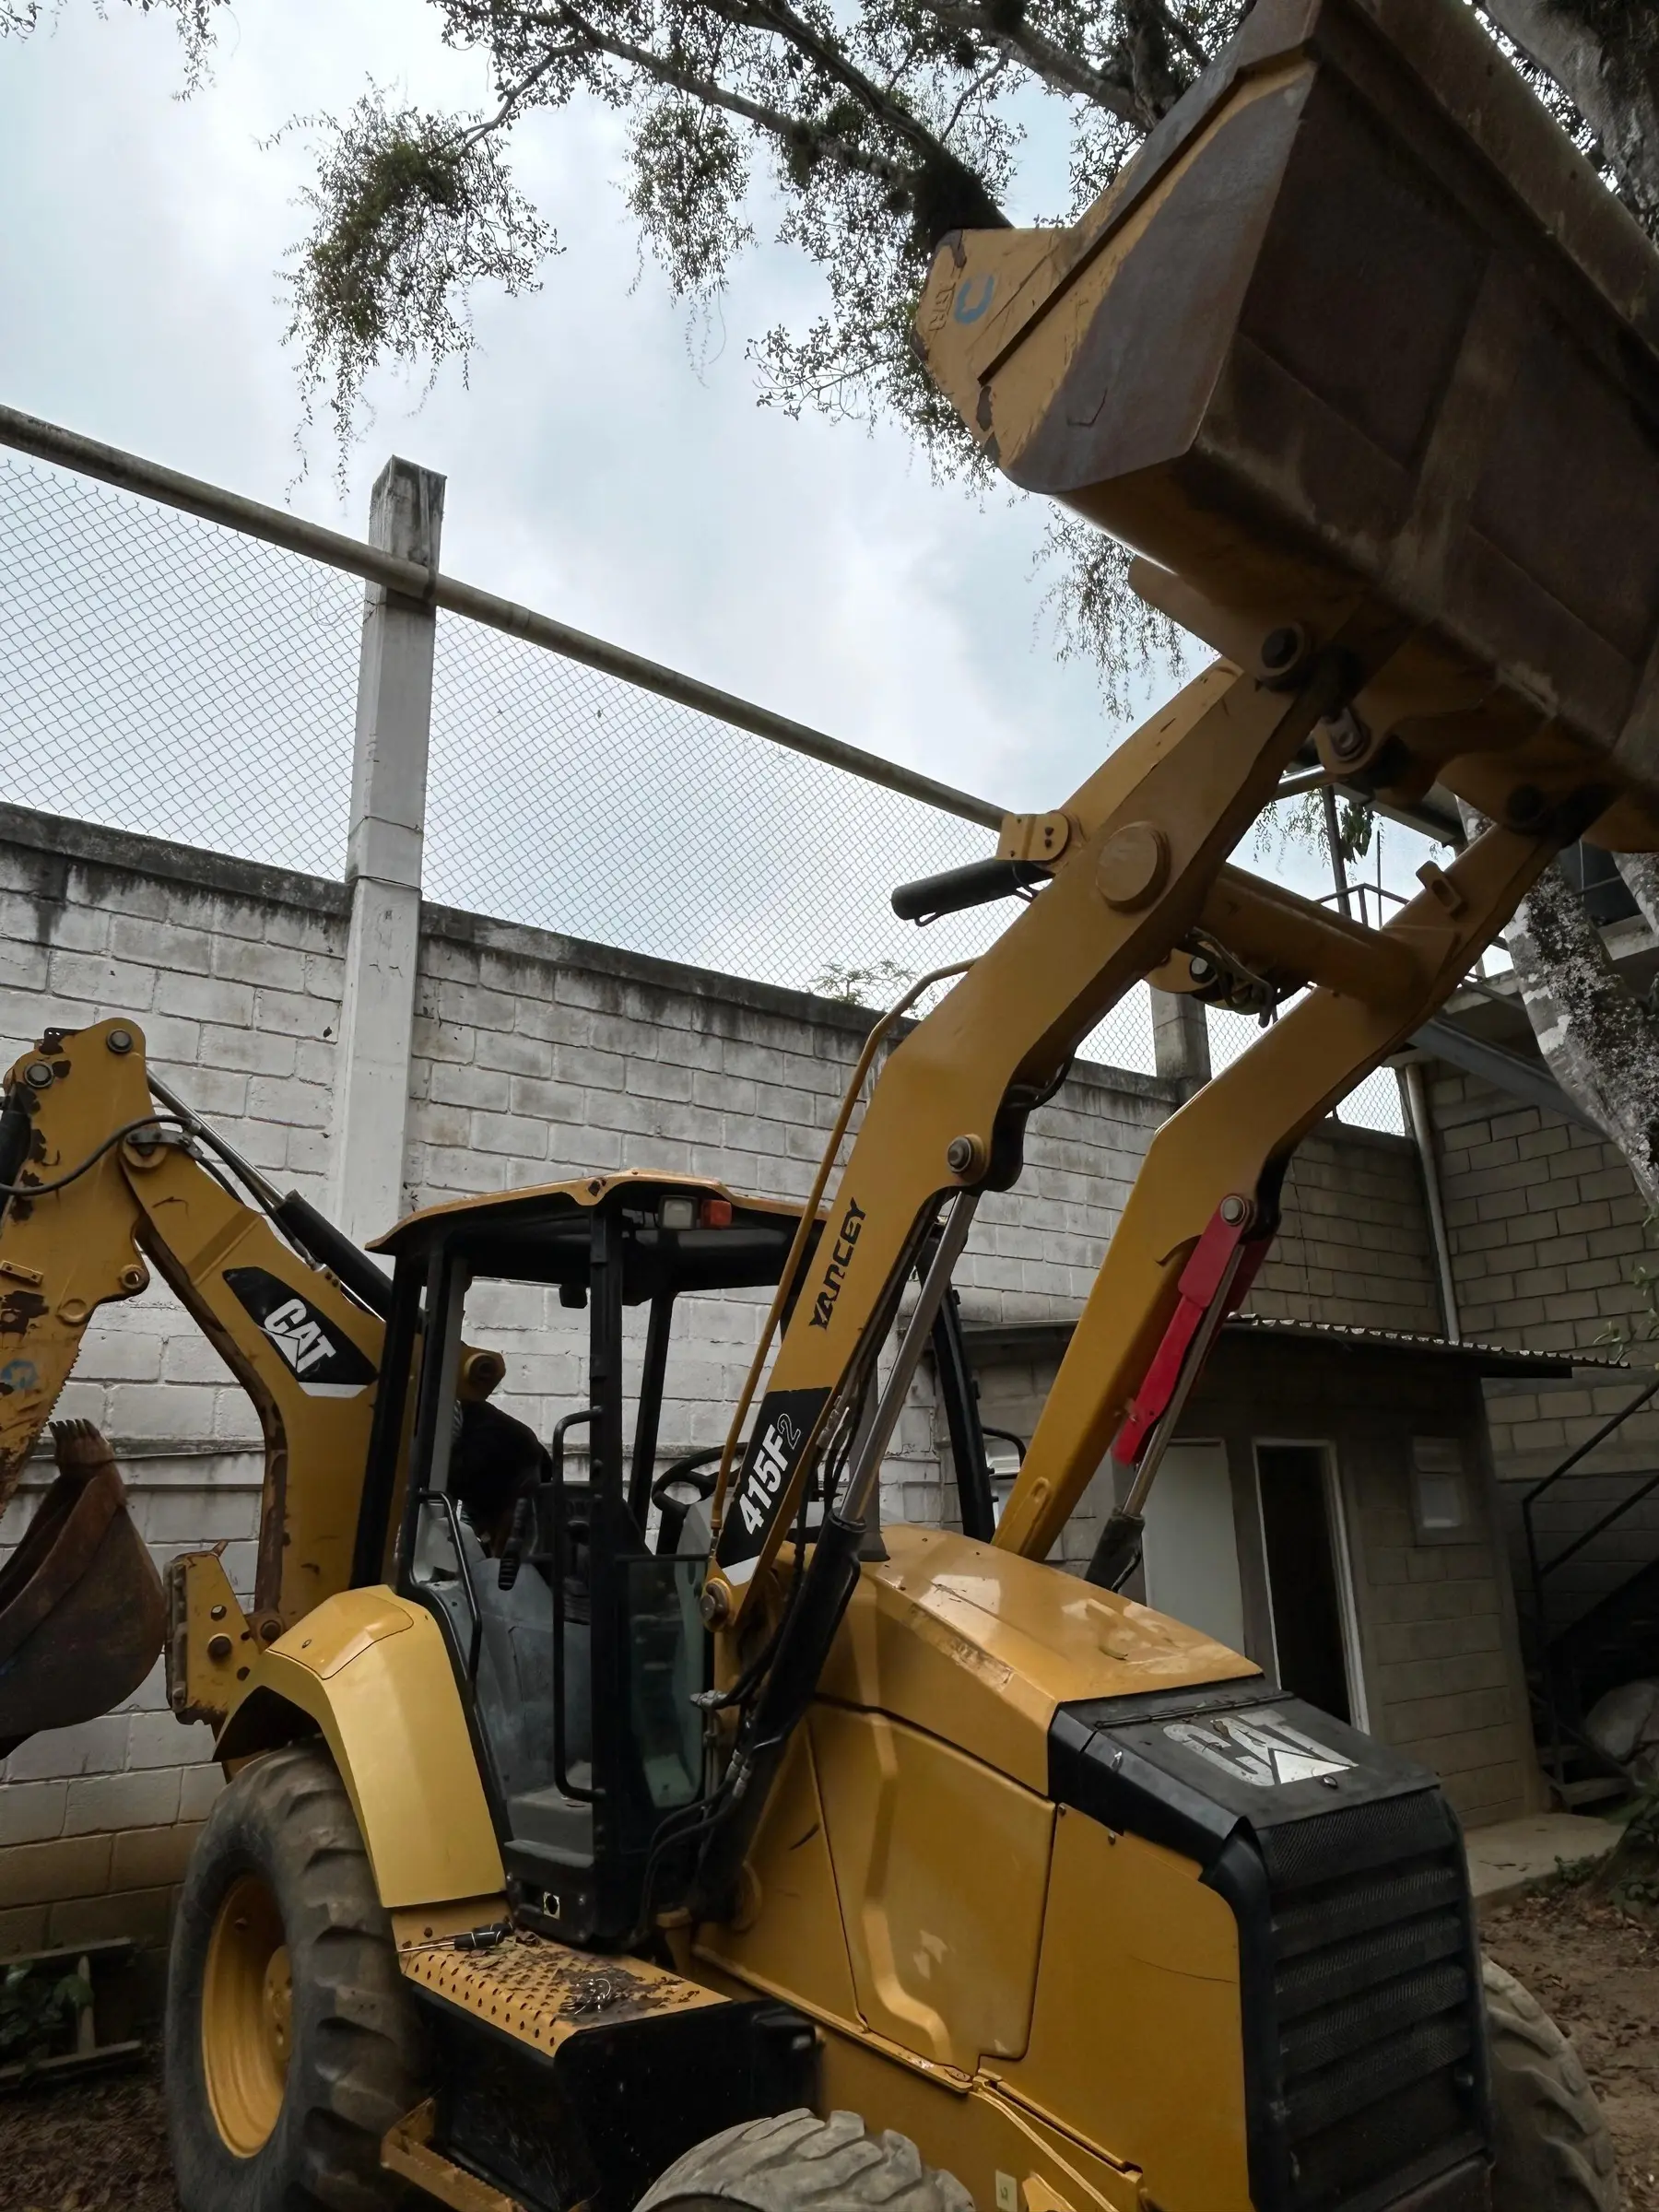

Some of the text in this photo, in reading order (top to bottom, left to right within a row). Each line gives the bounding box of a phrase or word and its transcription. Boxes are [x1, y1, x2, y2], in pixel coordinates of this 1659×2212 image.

[808, 1197, 866, 1331] YANCEY
[264, 1299, 336, 1373] CAT
[739, 1413, 802, 1535] 415F2
[1163, 1709, 1359, 1786] CAT
